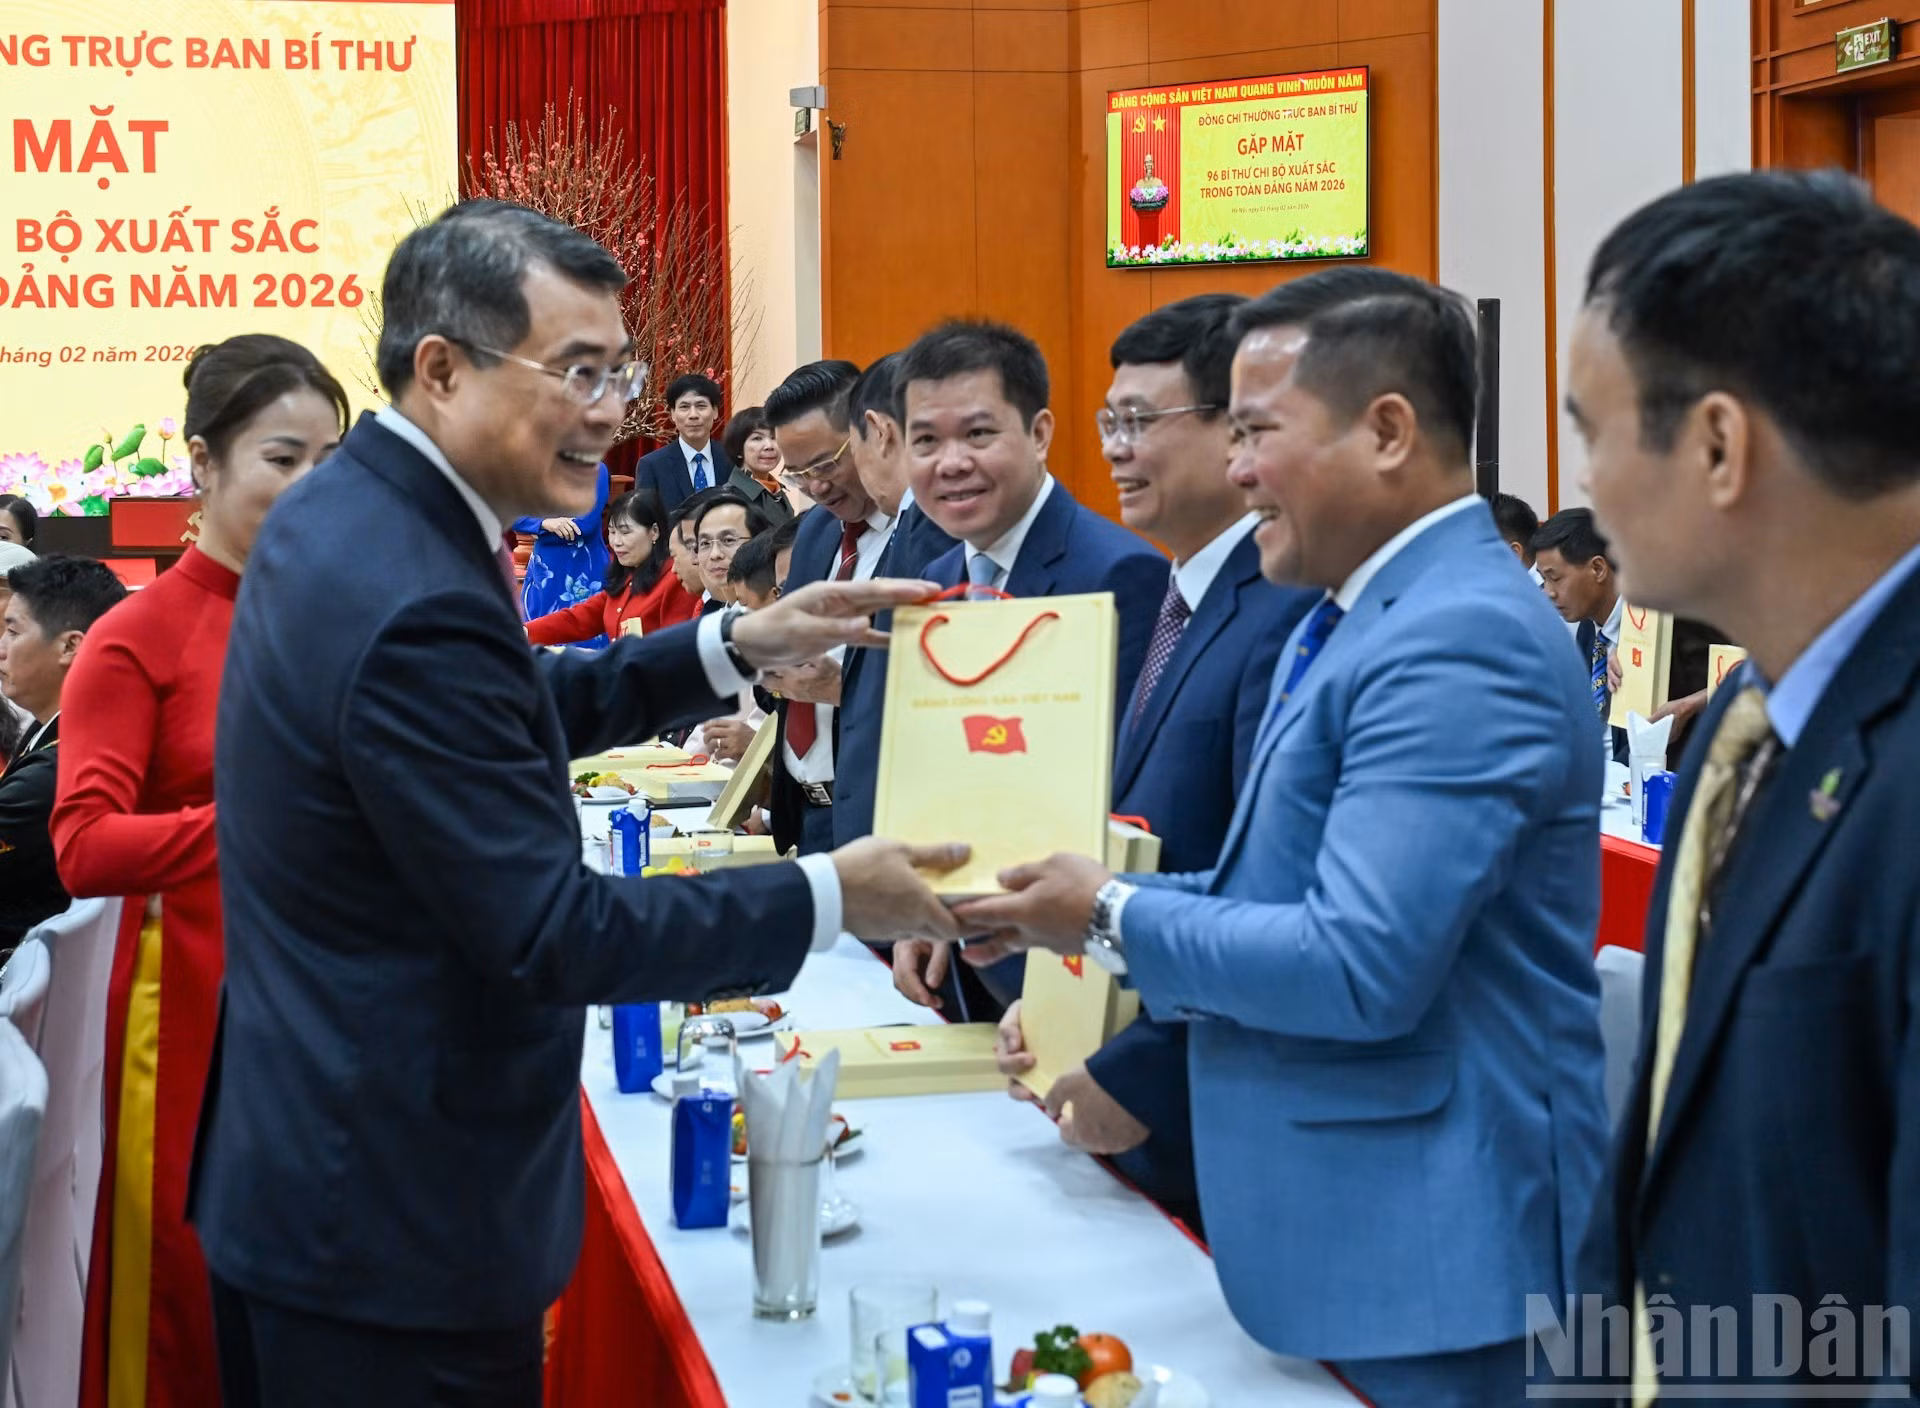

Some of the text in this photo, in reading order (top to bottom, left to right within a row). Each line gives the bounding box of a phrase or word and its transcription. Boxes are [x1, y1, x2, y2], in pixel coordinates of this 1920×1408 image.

[1865, 31, 1880, 44] EXIT
[62, 30, 173, 77] TRỰC
[186, 37, 271, 70] BAN
[285, 32, 320, 71] BÍ
[331, 35, 417, 72] THƯ
[1111, 72, 1363, 109] ĐẢNG CỘNG SẢN VIỆT NAM QUANG VINH MUÔN NĂM
[1226, 110, 1241, 124] CHÍ
[1243, 109, 1281, 123] THƯỜNG
[1282, 106, 1306, 120] TRỰC
[1308, 106, 1326, 118] BAN
[1329, 102, 1337, 115] BÍ
[1339, 101, 1358, 114] THƯ
[13, 104, 169, 190] MẶT
[1237, 130, 1305, 159] GẶP MẶT
[1207, 159, 1336, 182] 96 BÍ THƯ CHI BỘ XUẤT SẮC
[1200, 179, 1345, 198] TRONG TOÀN ĐẢNG NĂM 2026
[16, 205, 320, 263] BỘ XUẤT SẮC
[130, 264, 237, 308] NĂM
[252, 273, 364, 308] 2026
[59, 346, 86, 363] 02
[92, 346, 137, 362] năm
